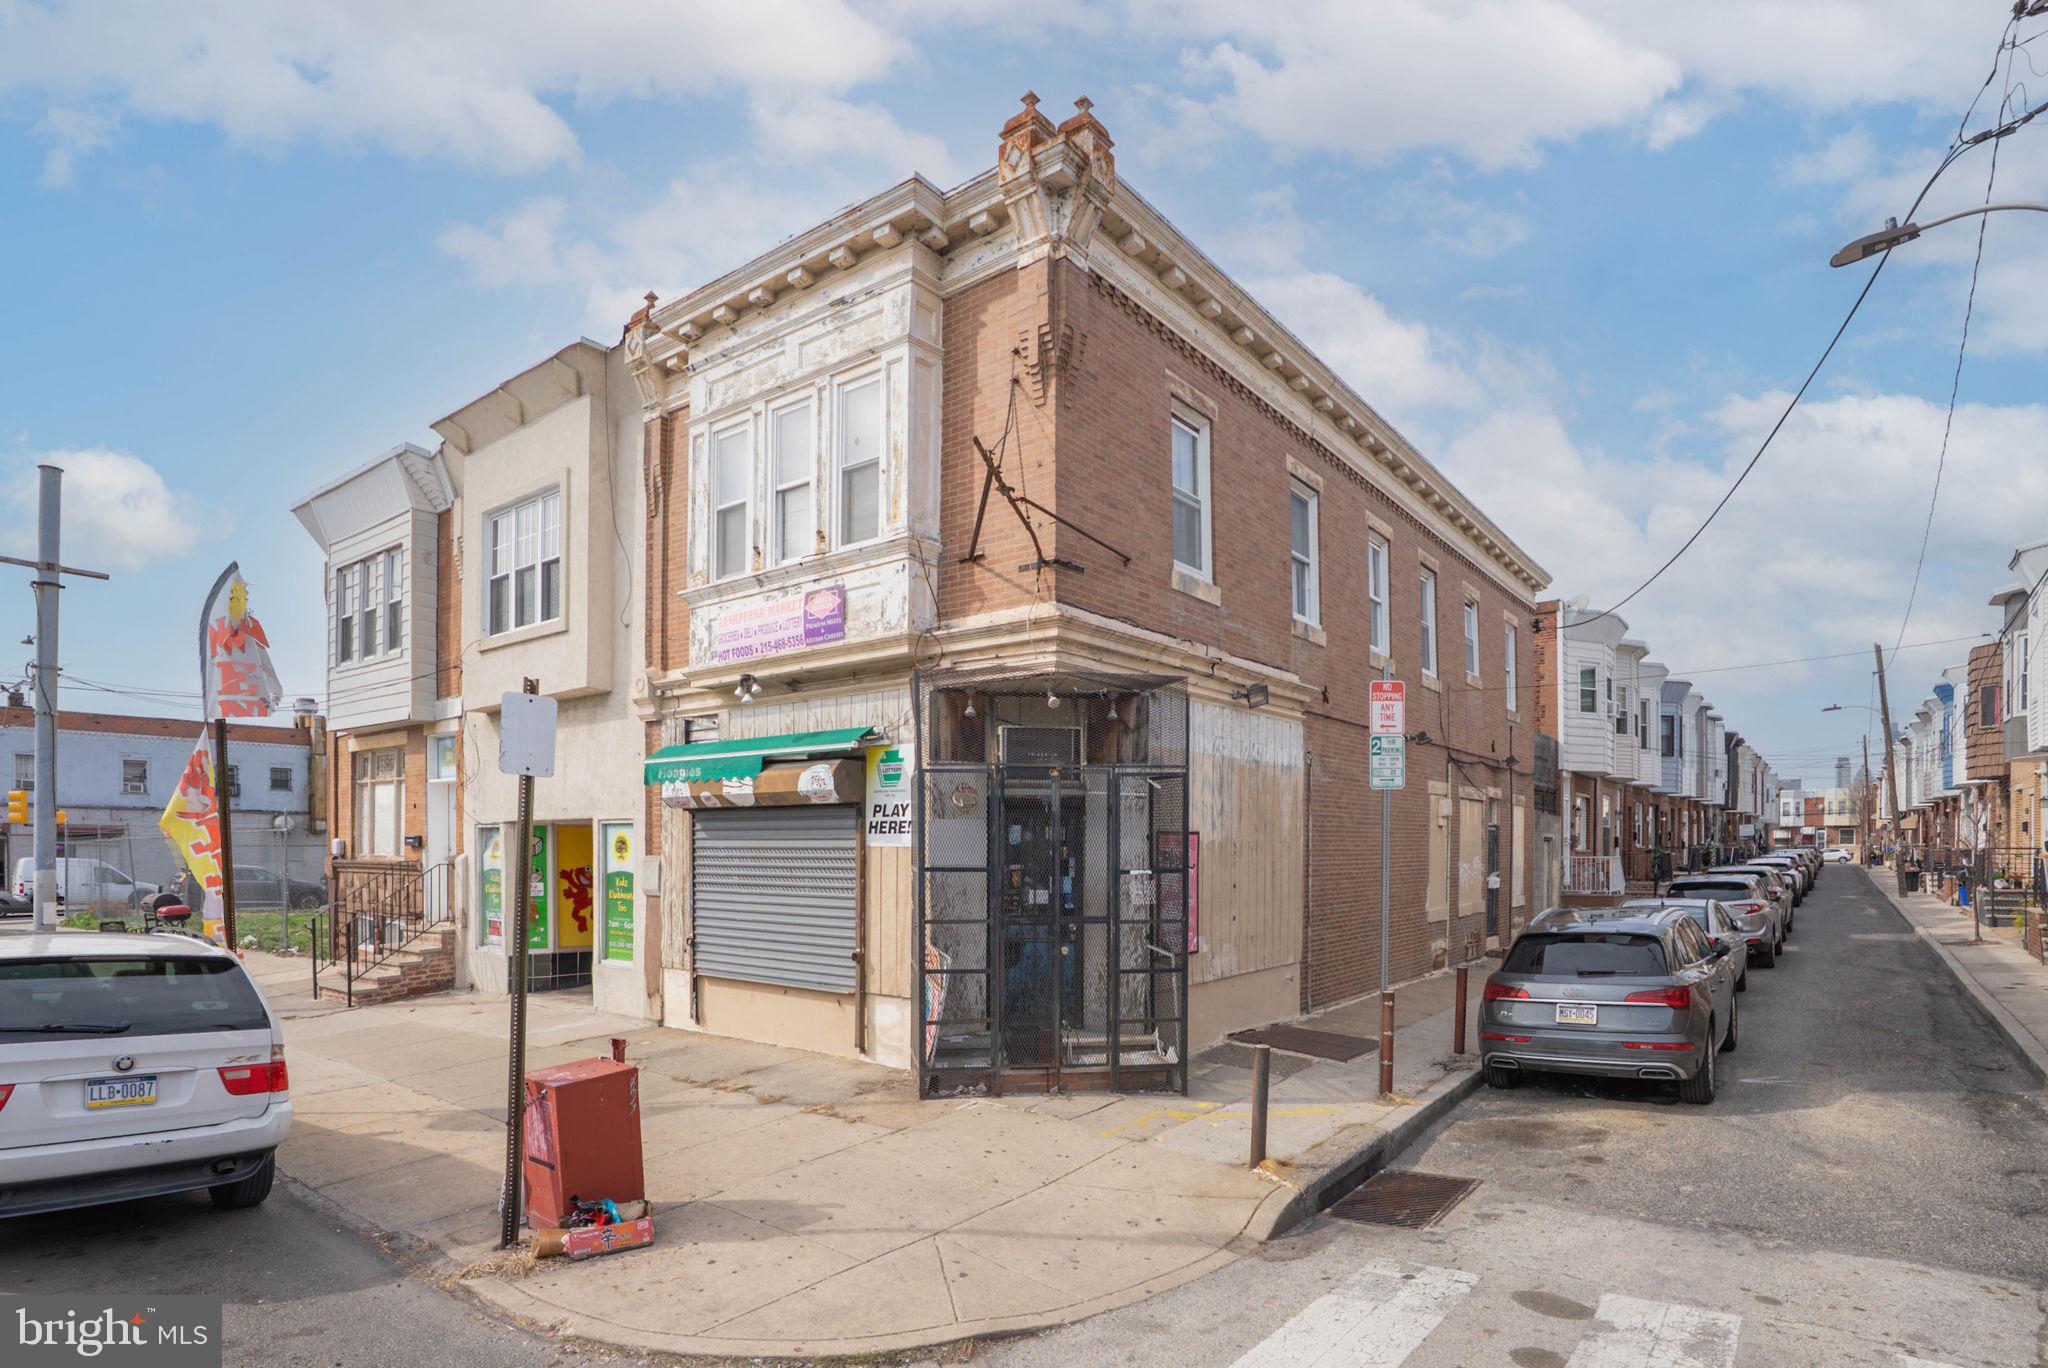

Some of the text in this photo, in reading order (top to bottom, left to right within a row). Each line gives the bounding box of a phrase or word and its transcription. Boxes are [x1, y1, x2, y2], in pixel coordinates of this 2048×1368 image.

[757, 621, 779, 635] PRODUCE
[718, 649, 731, 662] HOT
[732, 644, 754, 658] FOODS
[1383, 683, 1393, 691] NO
[1372, 692, 1403, 700] STOPPING
[1380, 713, 1396, 721] TIME
[1372, 740, 1381, 753] 2
[658, 766, 702, 781] Hoagies
[873, 803, 910, 818] PLAY
[868, 820, 912, 834] HERE!
[225, 1054, 261, 1064] X5
